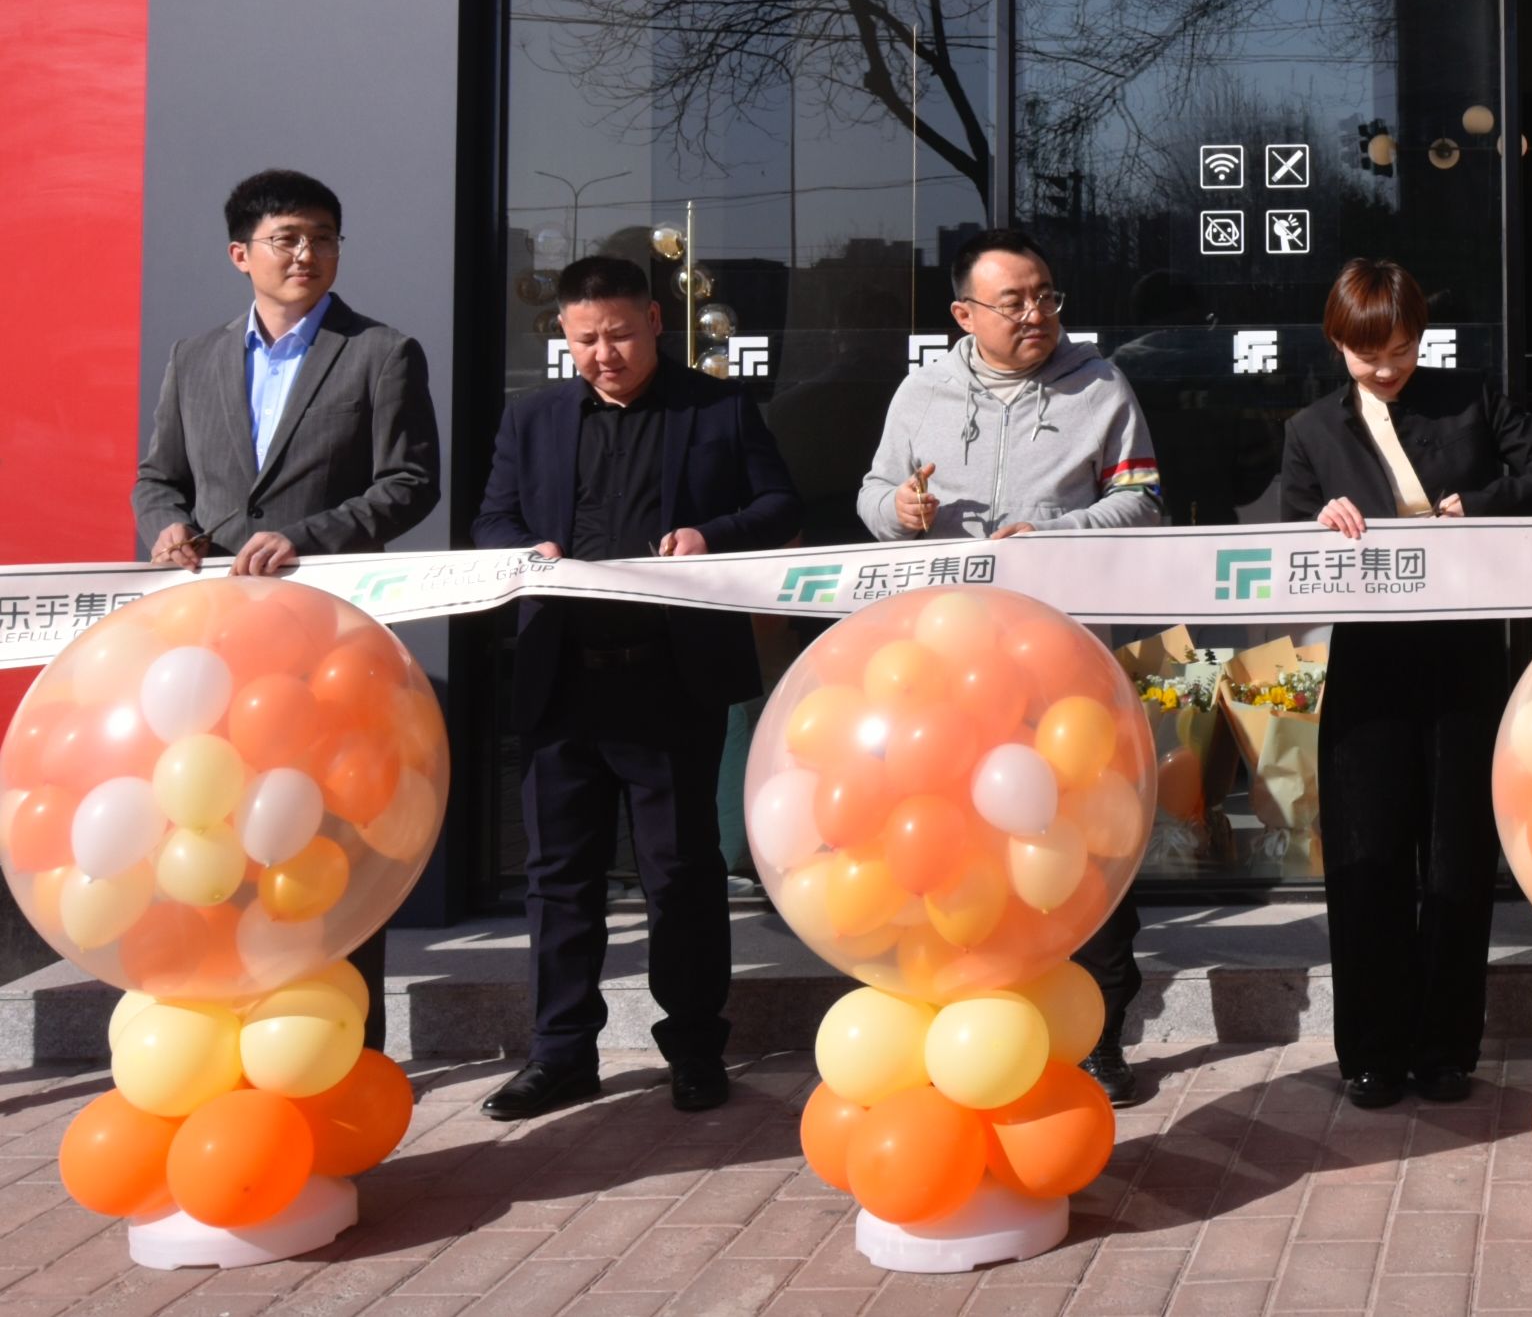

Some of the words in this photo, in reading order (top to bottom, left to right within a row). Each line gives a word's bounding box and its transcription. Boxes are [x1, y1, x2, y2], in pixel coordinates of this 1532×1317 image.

[854, 554, 996, 590] 乐乎集团
[1288, 547, 1426, 582] 乐乎集团
[1288, 582, 1356, 595] LEFULL
[1364, 581, 1426, 594] GROUP
